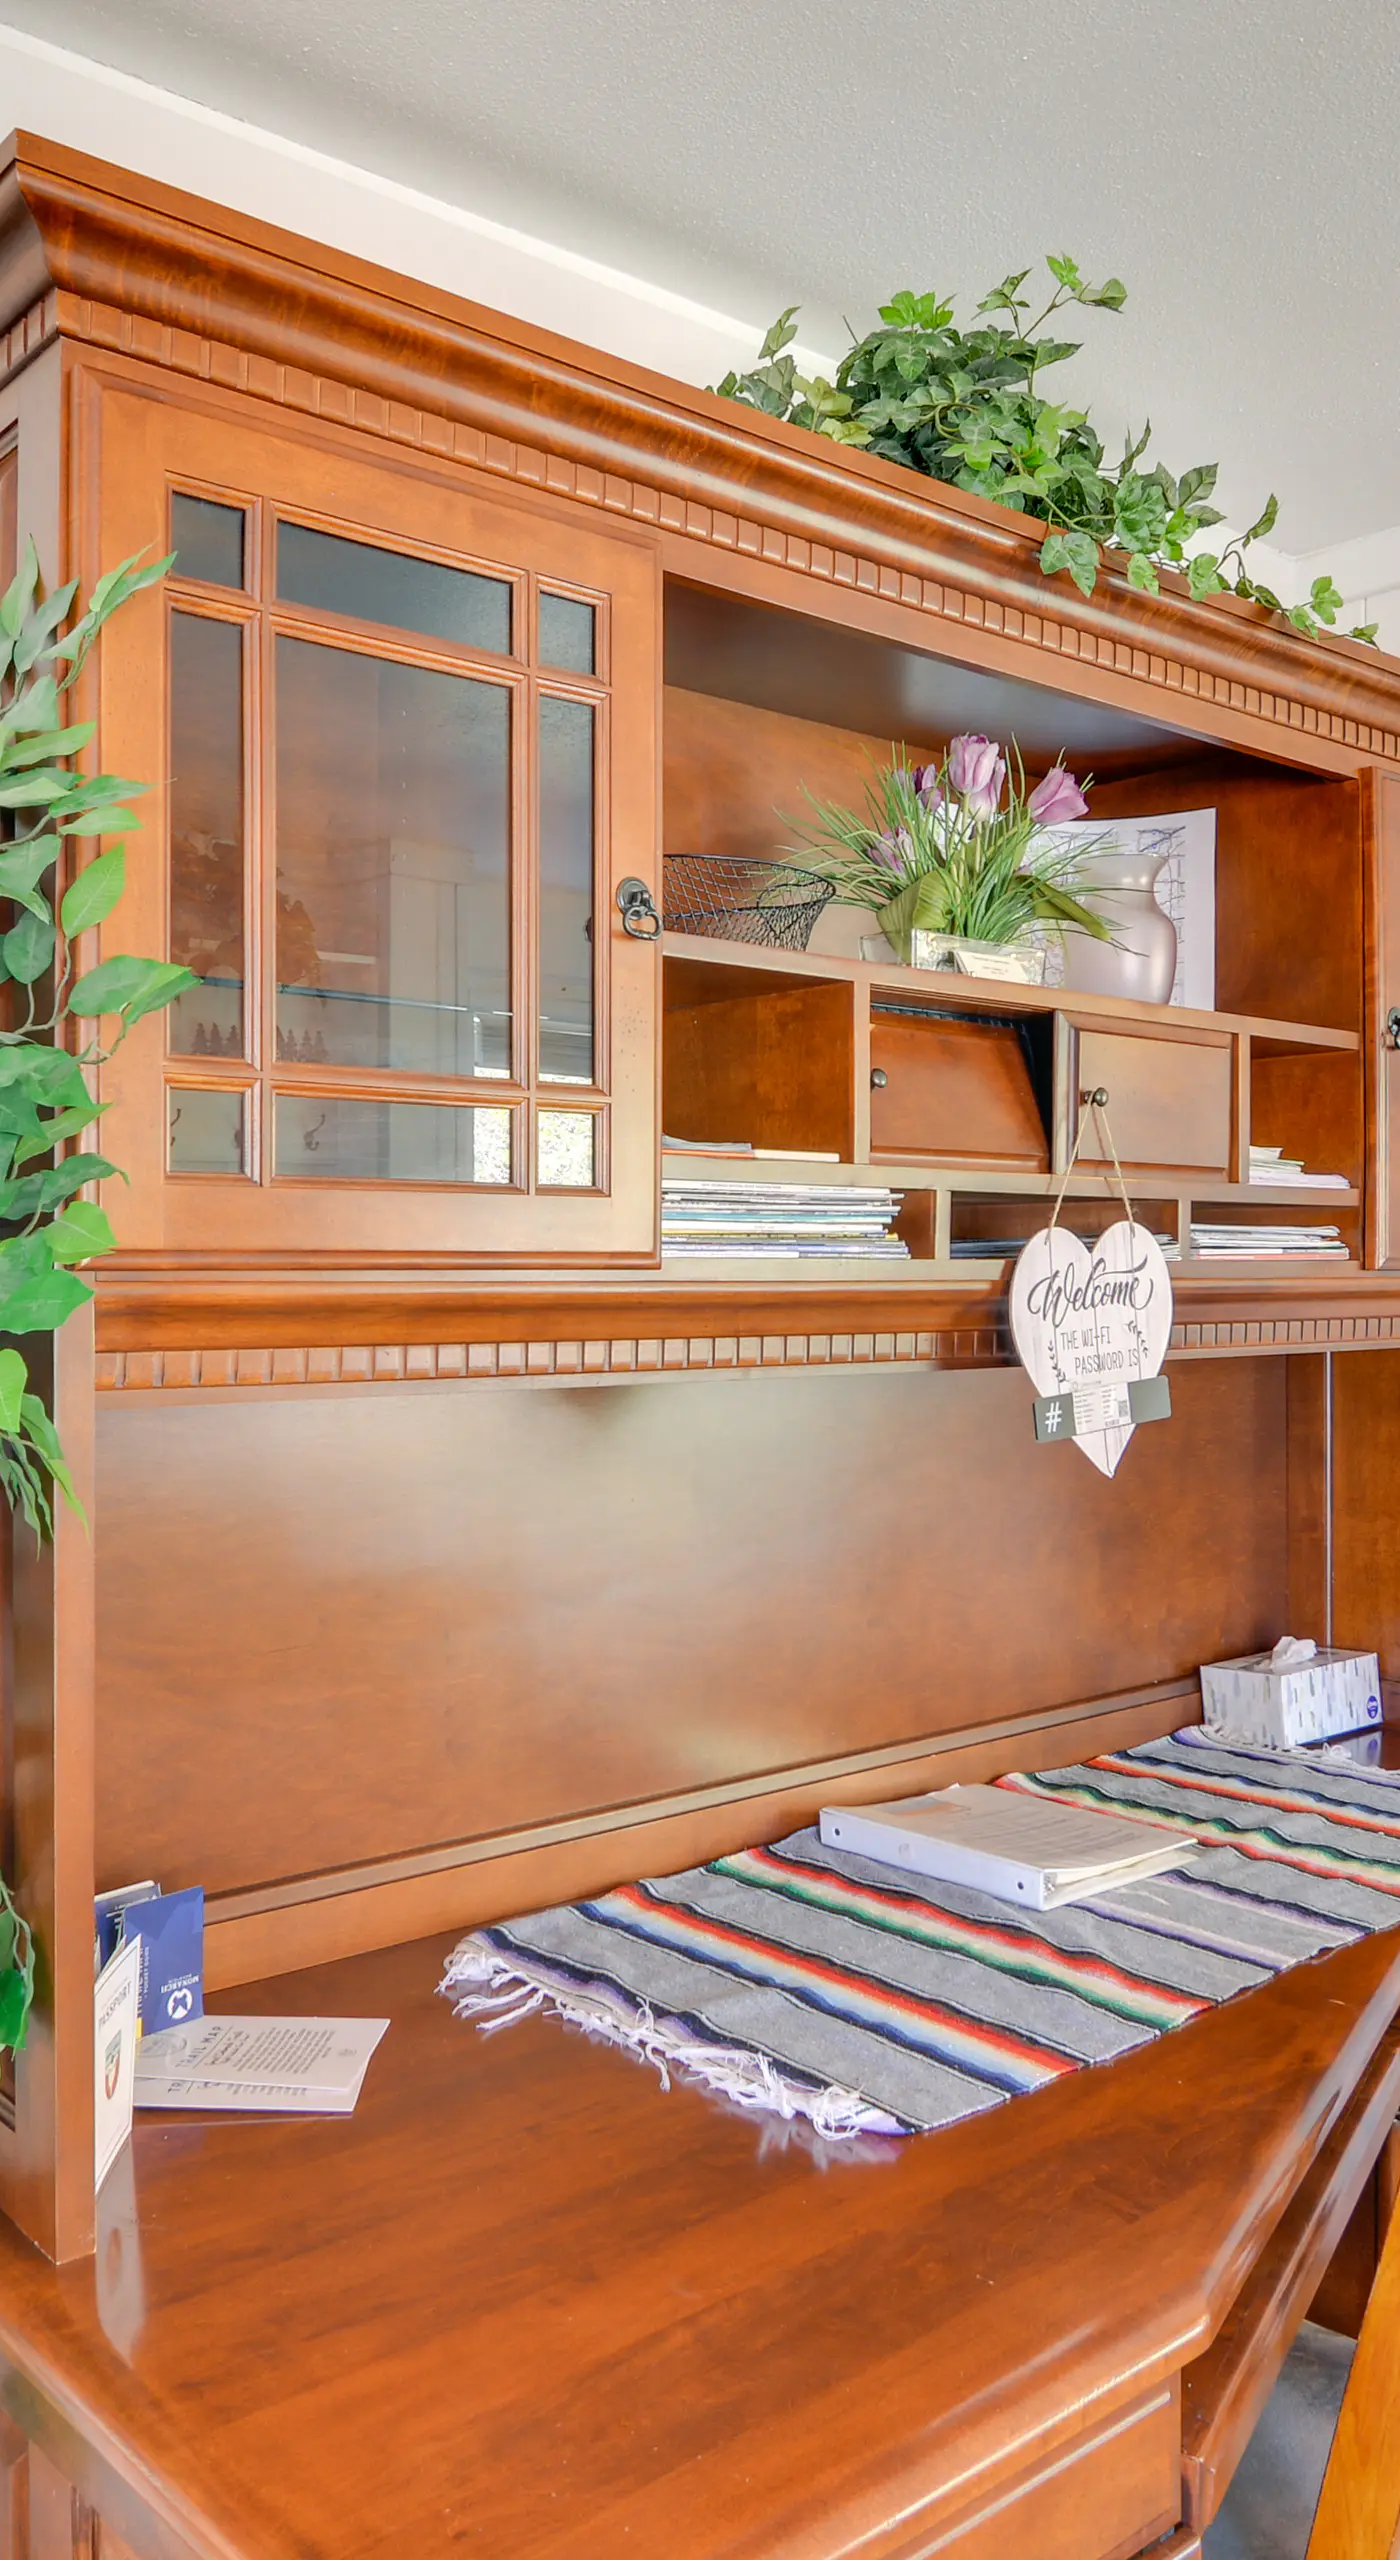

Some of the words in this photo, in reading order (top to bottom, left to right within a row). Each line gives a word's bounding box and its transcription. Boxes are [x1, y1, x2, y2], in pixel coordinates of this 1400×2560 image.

[1027, 1254, 1153, 1328] Welcome
[1060, 1330, 1079, 1350] THE
[1081, 1325, 1111, 1348] WI-FI
[1074, 1350, 1124, 1376] PASSWORD
[1128, 1348, 1140, 1368] IS
[160, 1974, 200, 1994] MONARCH
[98, 1979, 132, 2031] PASSPORT
[174, 2045, 207, 2069] TRAIL
[201, 2026, 221, 2044] MAP
